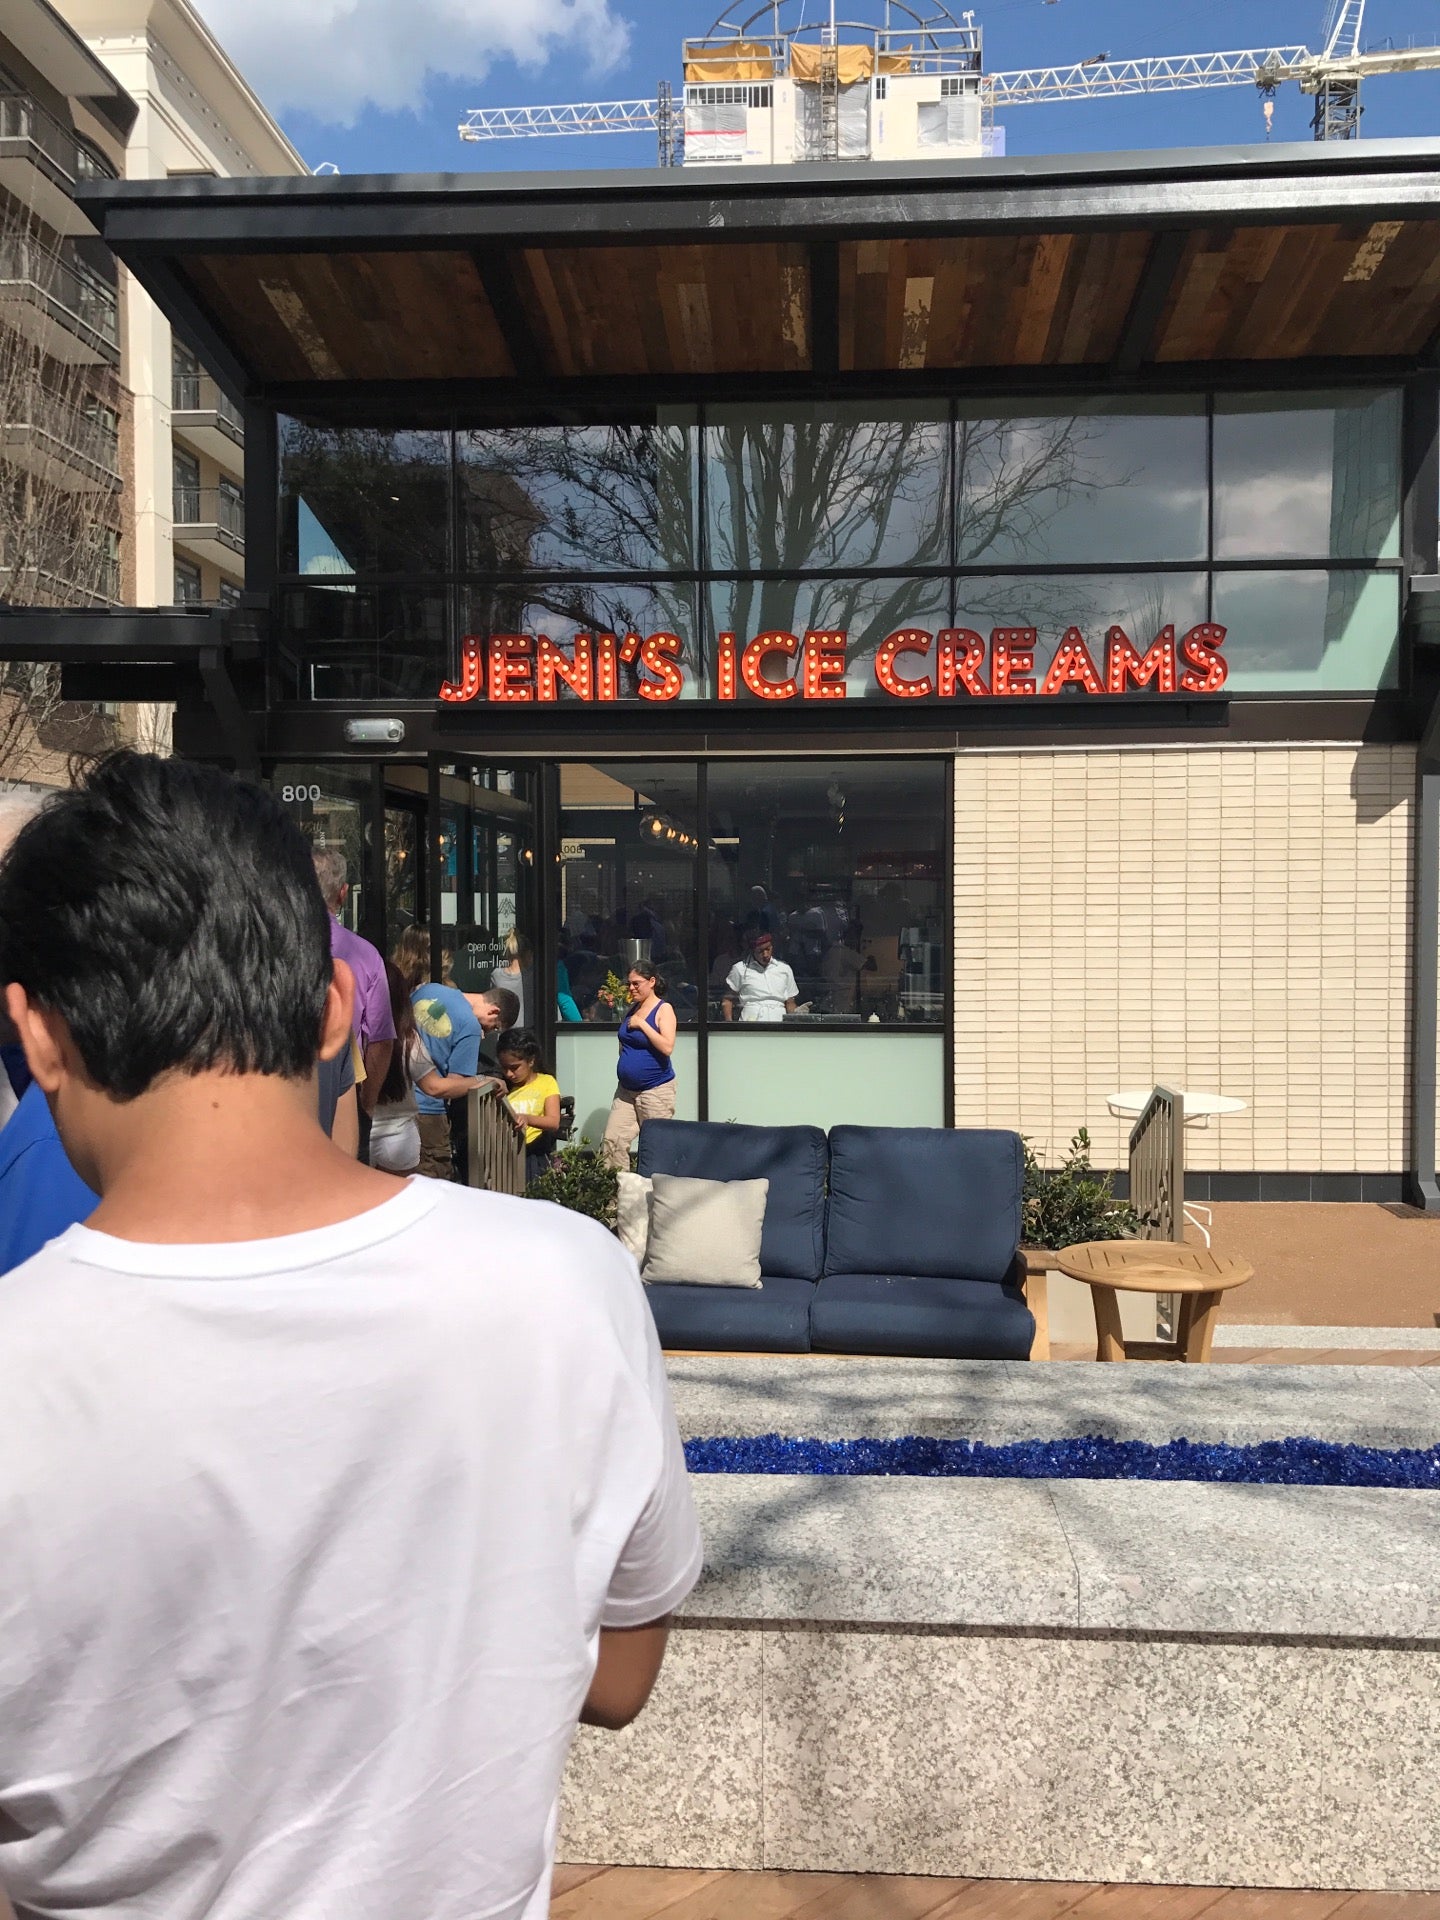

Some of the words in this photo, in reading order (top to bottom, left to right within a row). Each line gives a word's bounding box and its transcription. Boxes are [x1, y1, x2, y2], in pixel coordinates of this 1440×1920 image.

[439, 630, 685, 701] JENI'S
[718, 630, 848, 699] ICE
[874, 623, 1229, 697] CREAMS
[282, 784, 321, 802] 800
[467, 942, 487, 954] open
[489, 937, 507, 956] daily
